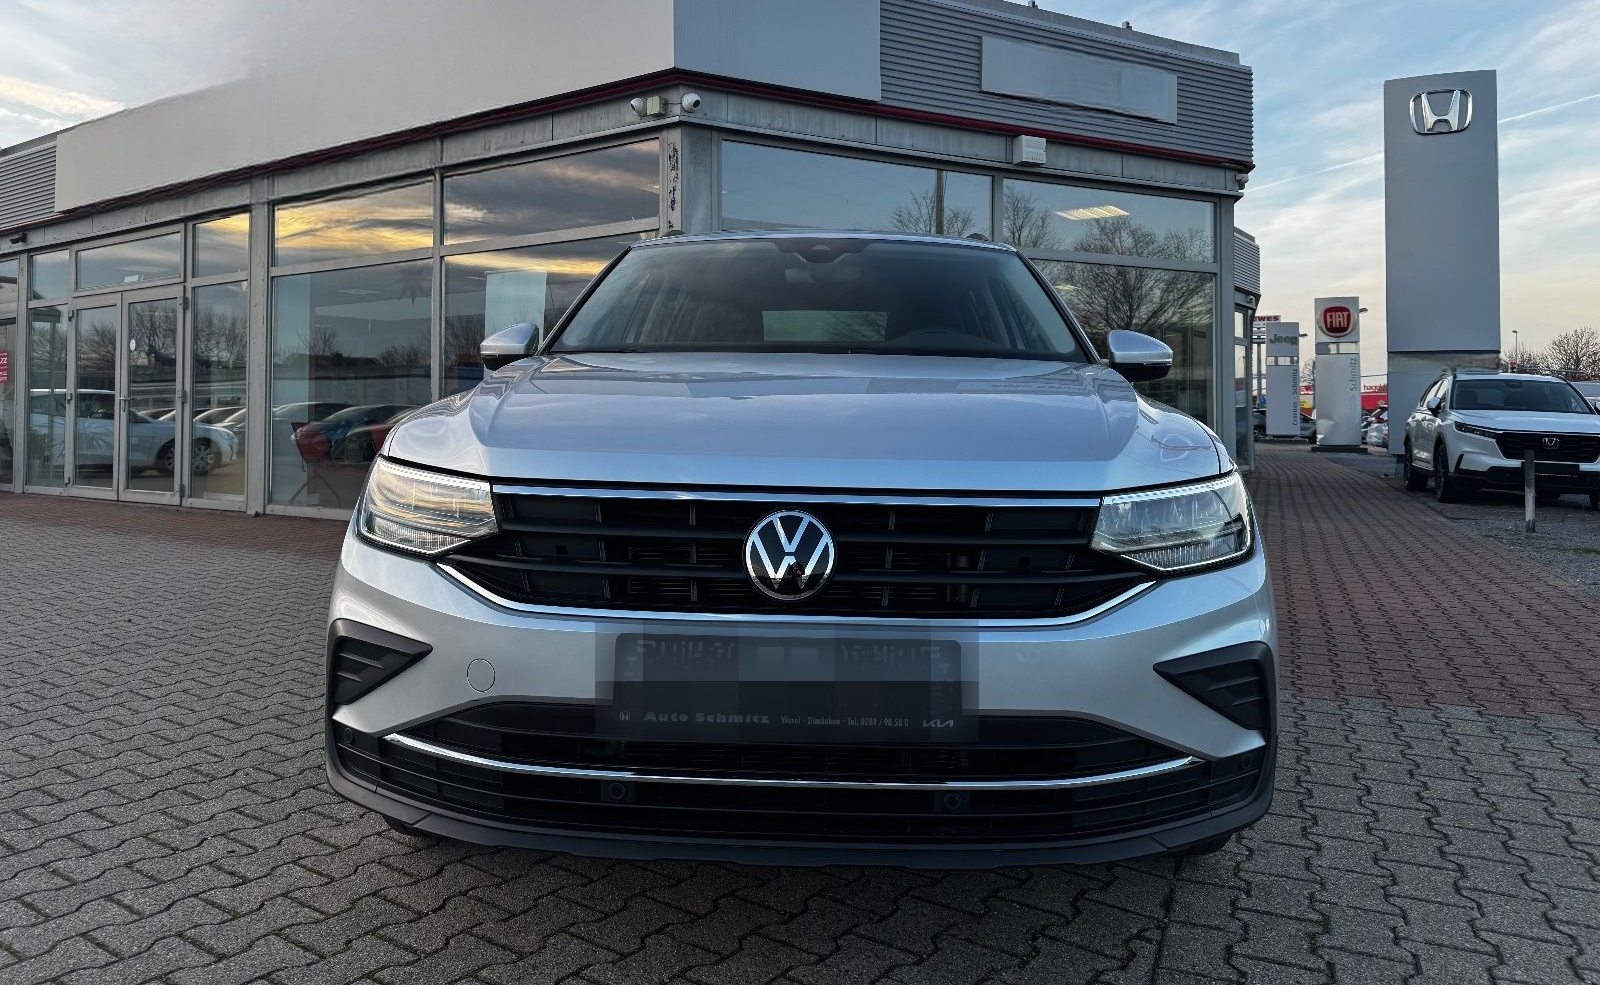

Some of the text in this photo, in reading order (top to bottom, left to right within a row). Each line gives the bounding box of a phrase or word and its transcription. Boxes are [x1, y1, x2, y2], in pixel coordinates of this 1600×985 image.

[1326, 311, 1349, 328] FIAT
[1269, 334, 1299, 345] Jeep
[644, 711, 770, 723] Auto Schmitz
[780, 715, 801, 724] Wesel
[806, 716, 841, 725] Dinslaken
[847, 717, 860, 726] Tel.
[860, 717, 877, 726] 0281
